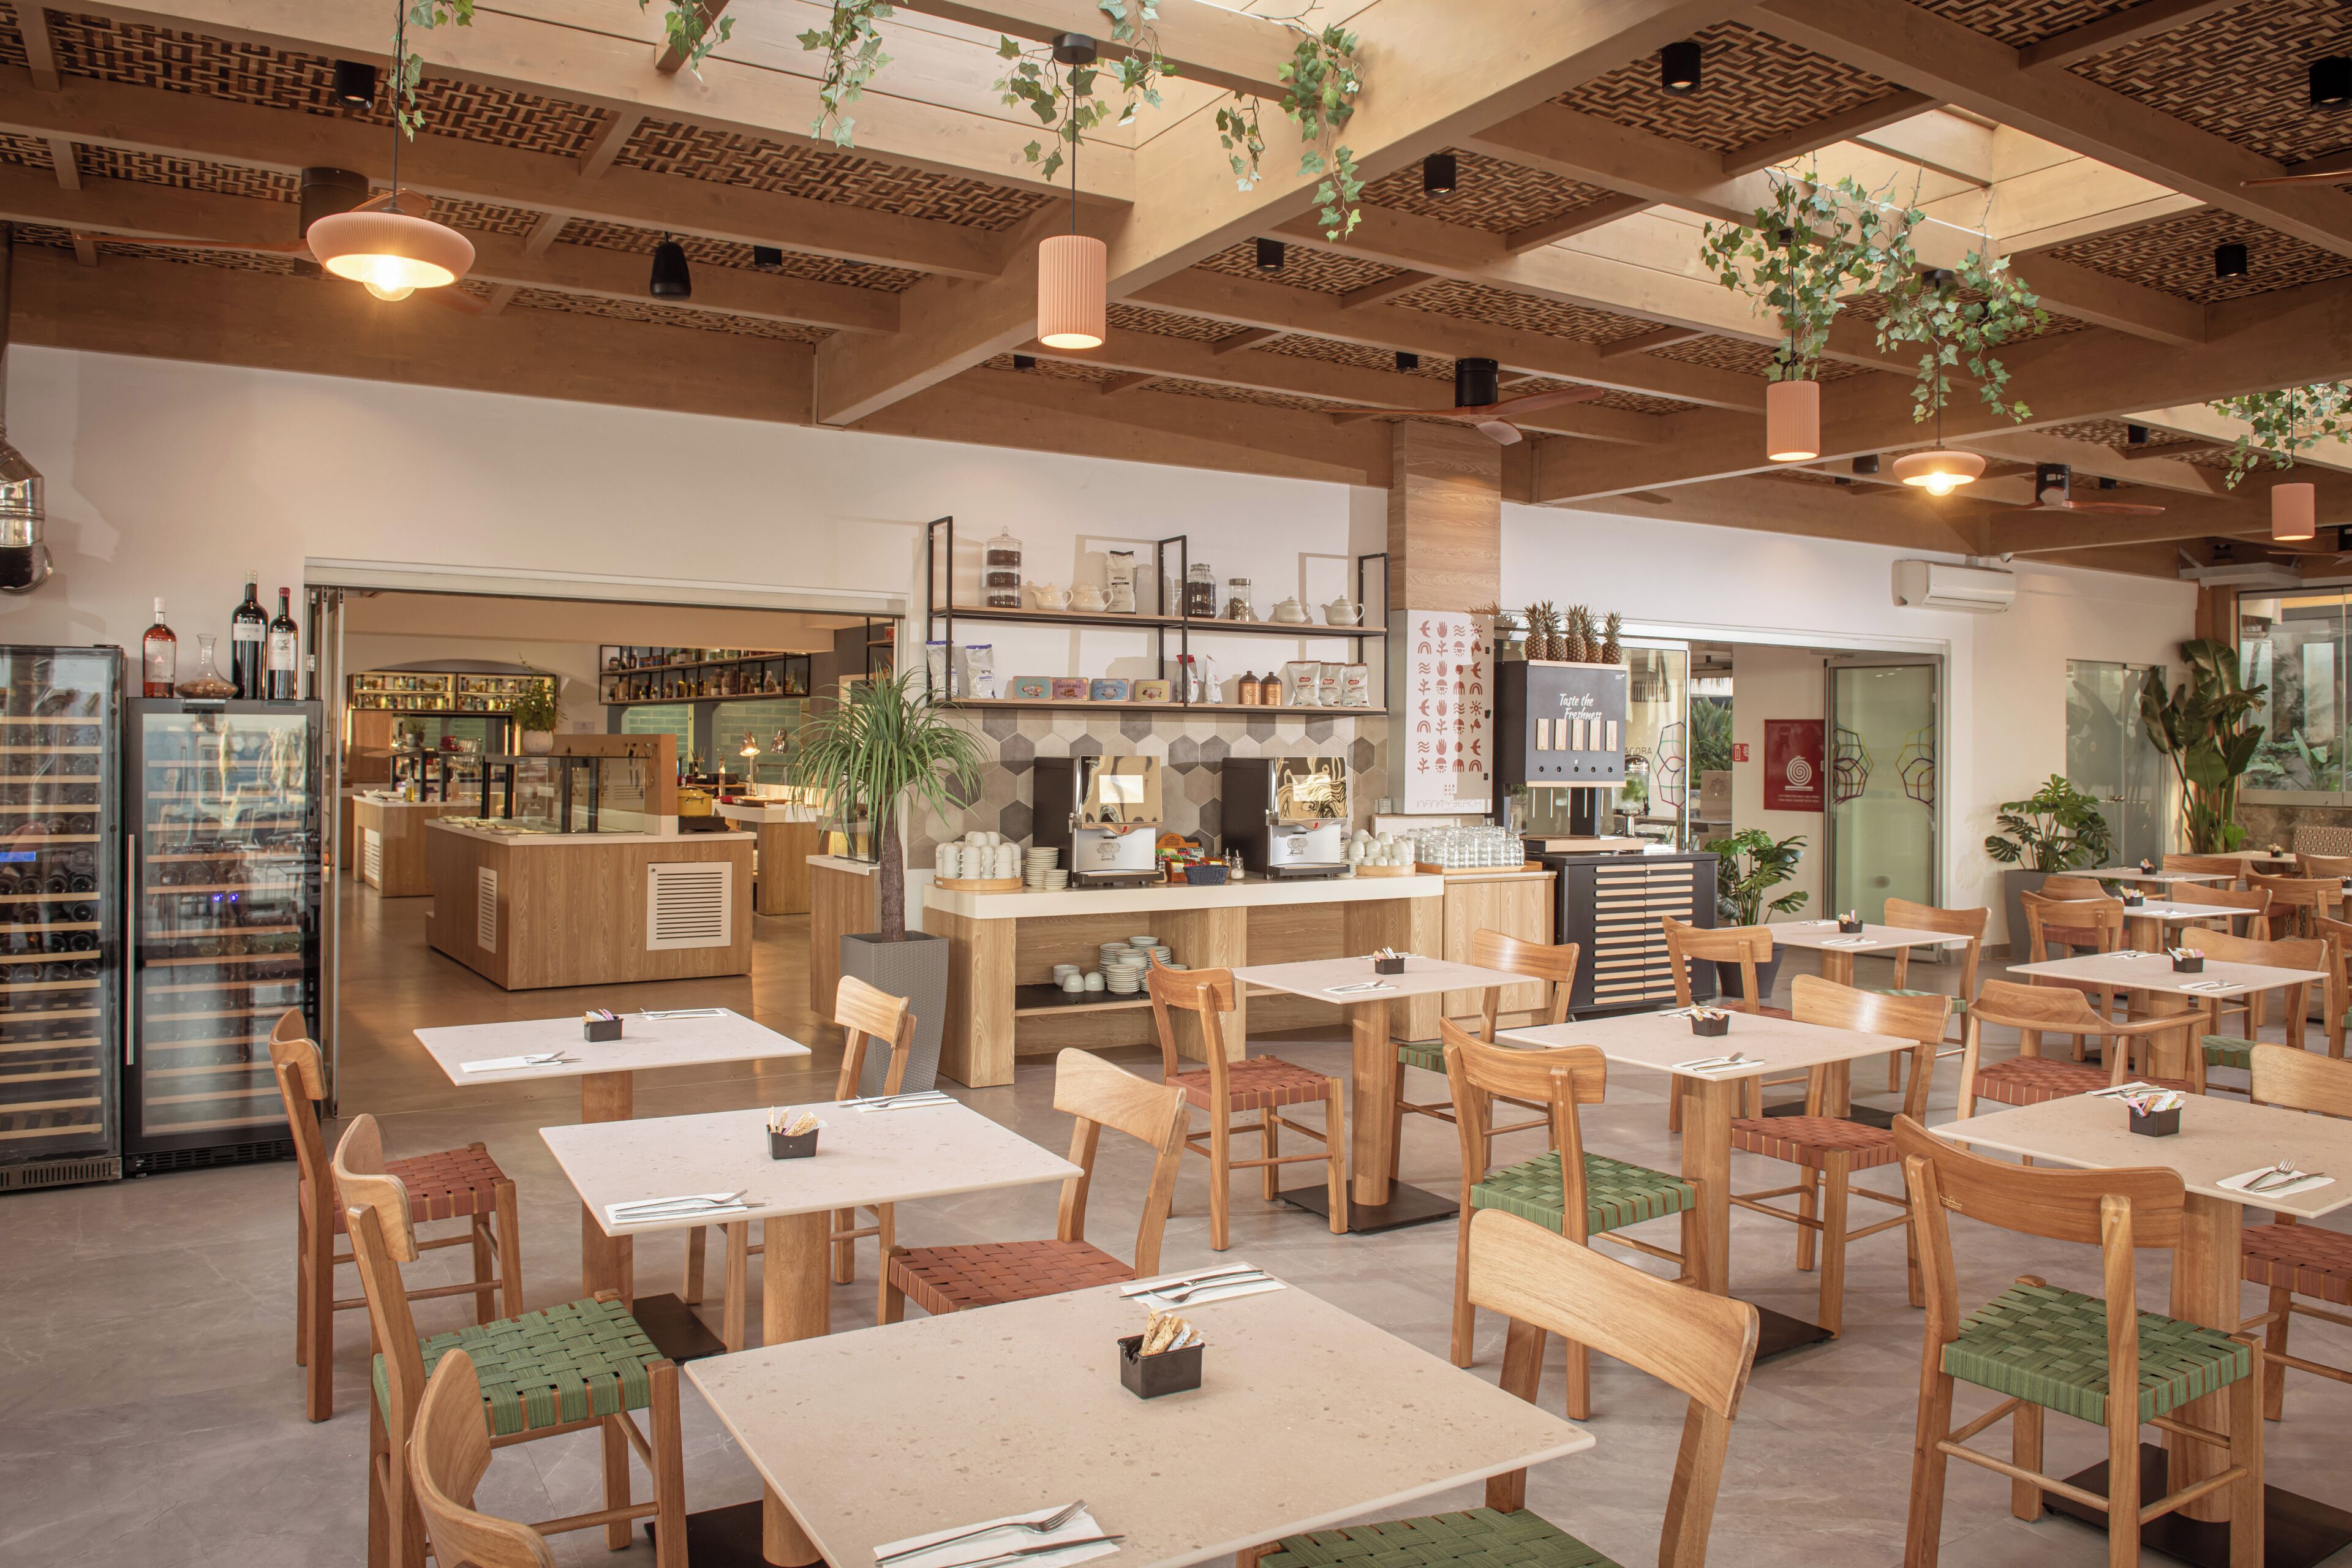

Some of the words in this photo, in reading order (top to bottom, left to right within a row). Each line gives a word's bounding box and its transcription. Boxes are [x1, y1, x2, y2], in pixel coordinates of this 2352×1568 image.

[1559, 693, 1580, 706] Taste
[1581, 693, 1594, 706] the
[1564, 707, 1602, 720] Freshness
[1416, 799, 1452, 808] INFINITY
